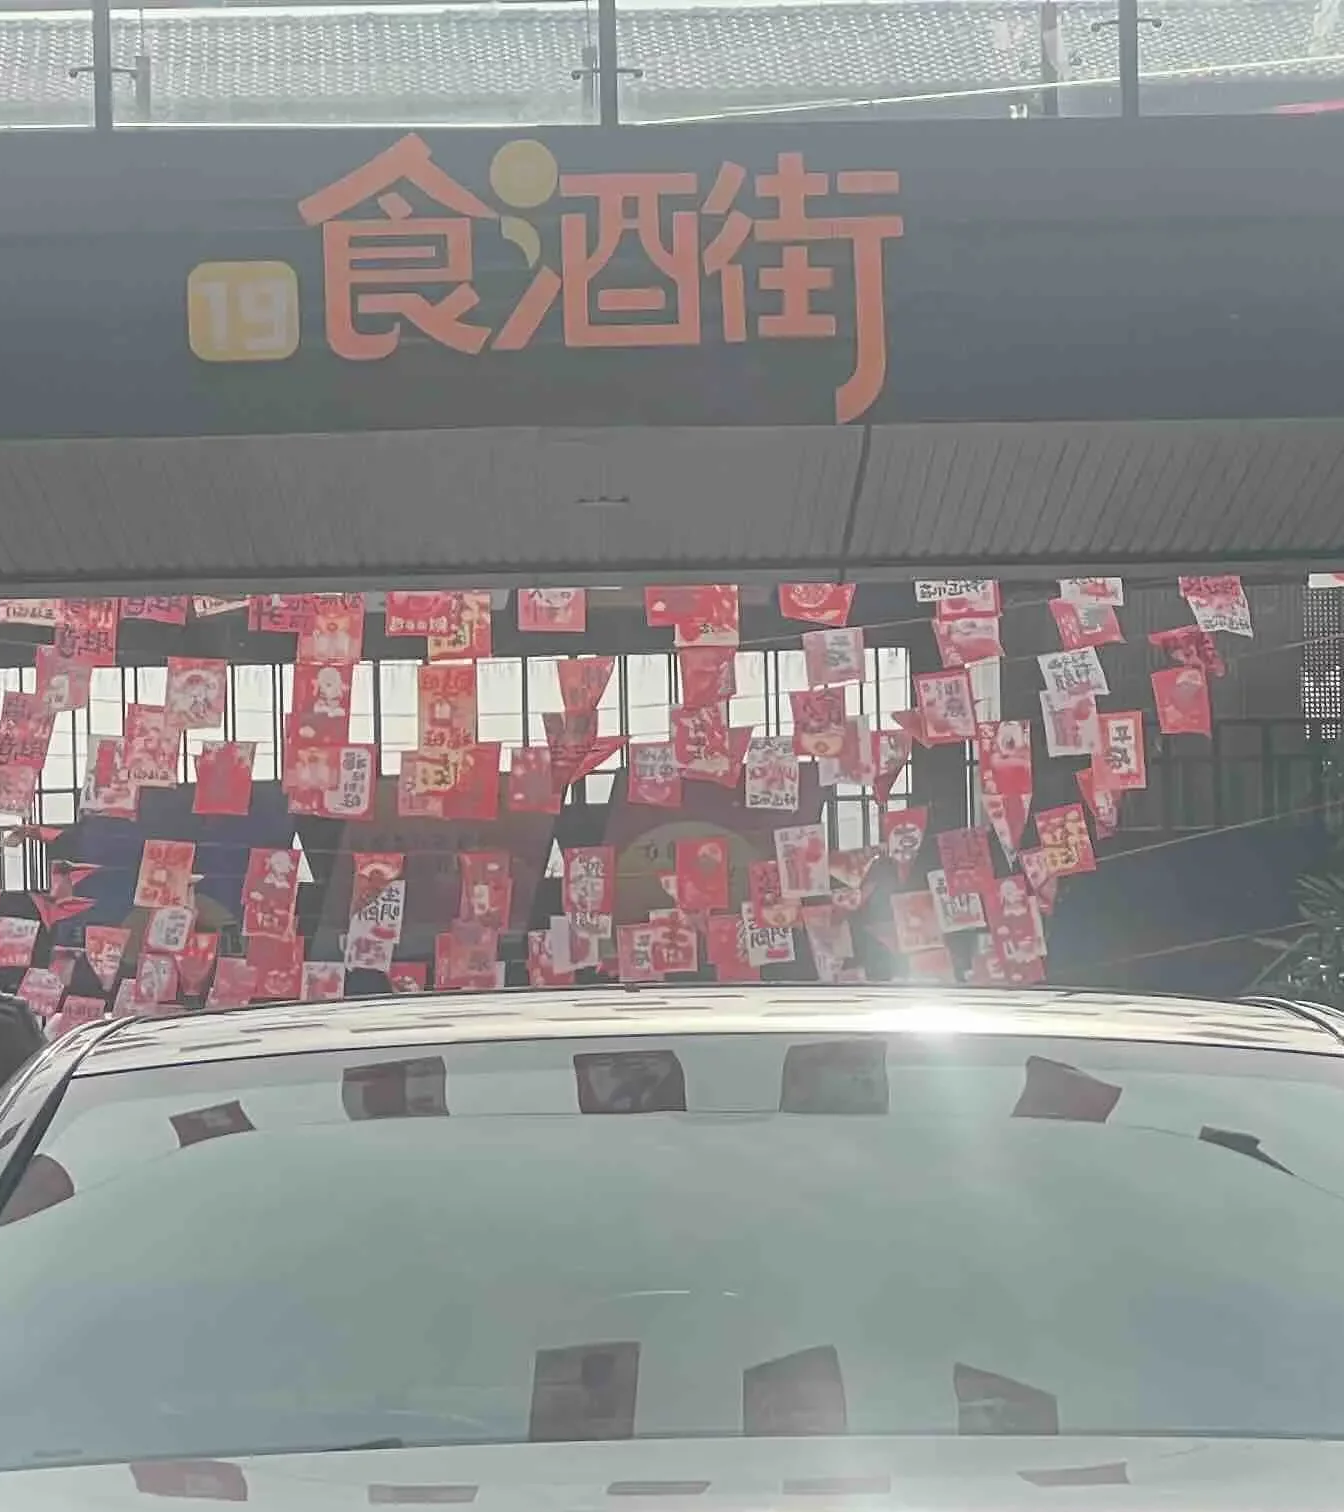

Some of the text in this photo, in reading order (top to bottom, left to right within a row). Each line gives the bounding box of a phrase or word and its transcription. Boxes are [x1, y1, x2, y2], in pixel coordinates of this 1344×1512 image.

[191, 279, 288, 351] 19
[297, 132, 905, 424] 食酒街
